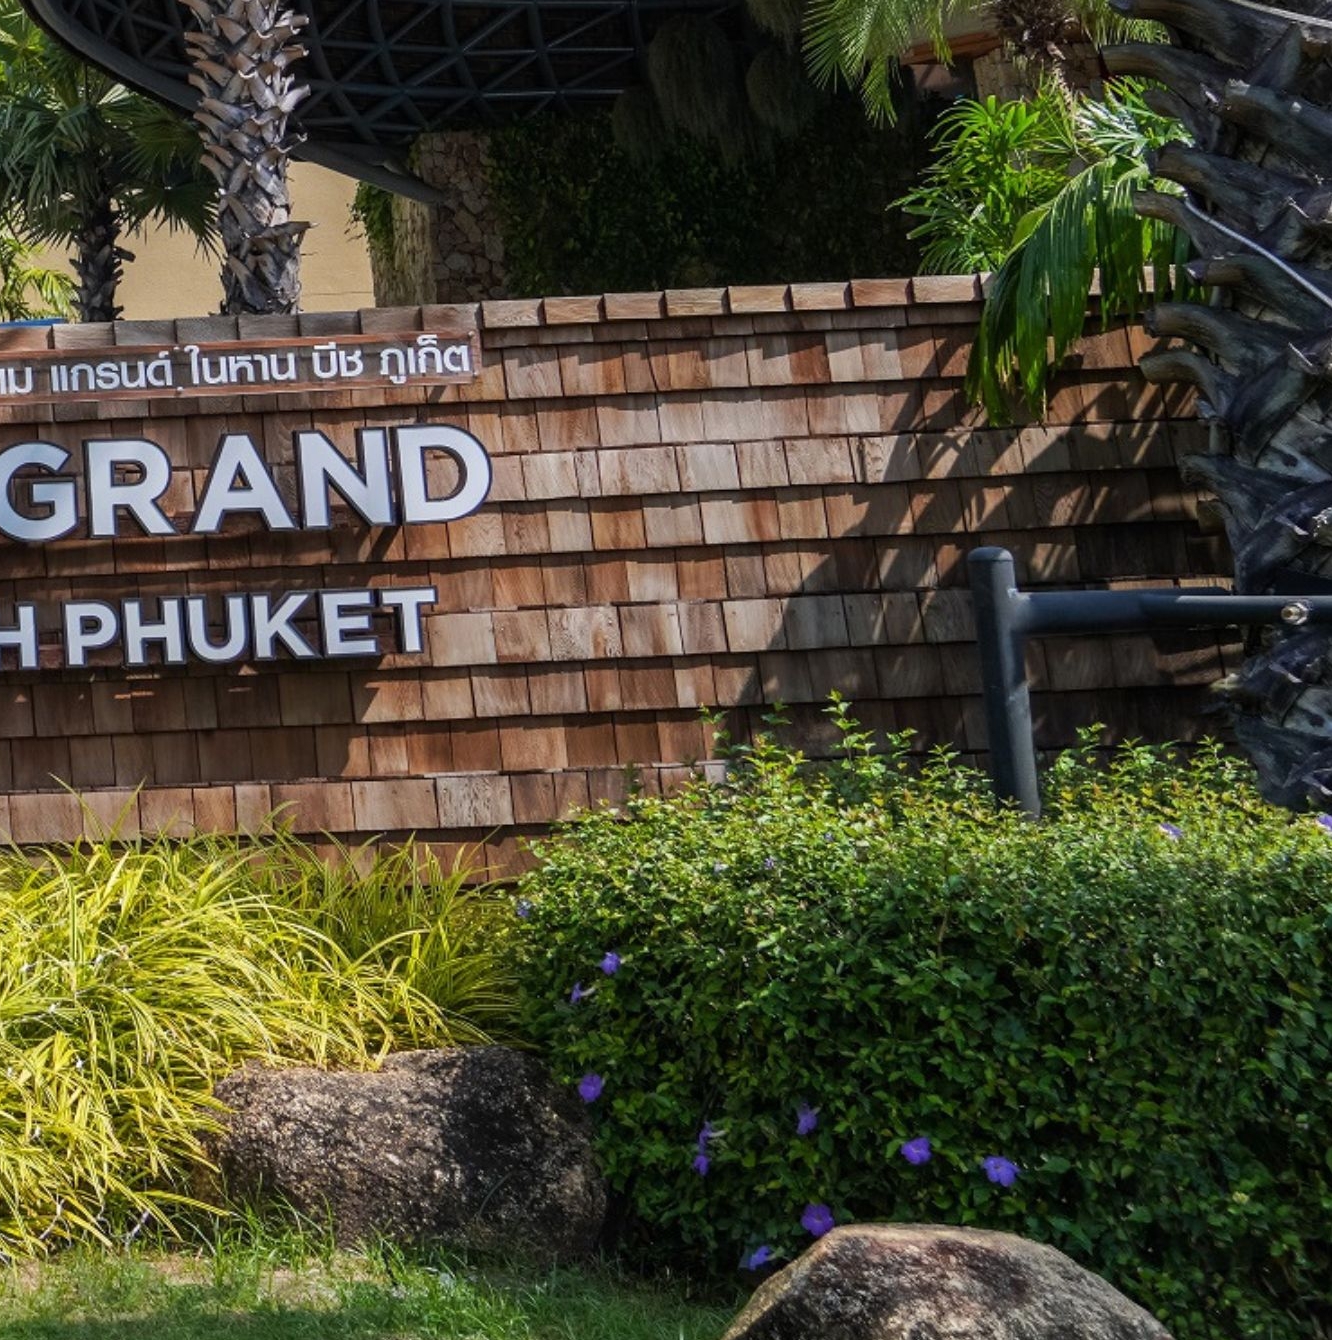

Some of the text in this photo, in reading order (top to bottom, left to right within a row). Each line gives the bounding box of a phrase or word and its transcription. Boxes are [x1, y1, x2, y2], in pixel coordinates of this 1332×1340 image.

[50, 350, 174, 392] แกรนด์
[184, 345, 296, 385] ในหาน
[311, 342, 365, 379] บีช
[379, 334, 471, 385] ภูเก็ต
[61, 584, 438, 668] PHUKET
